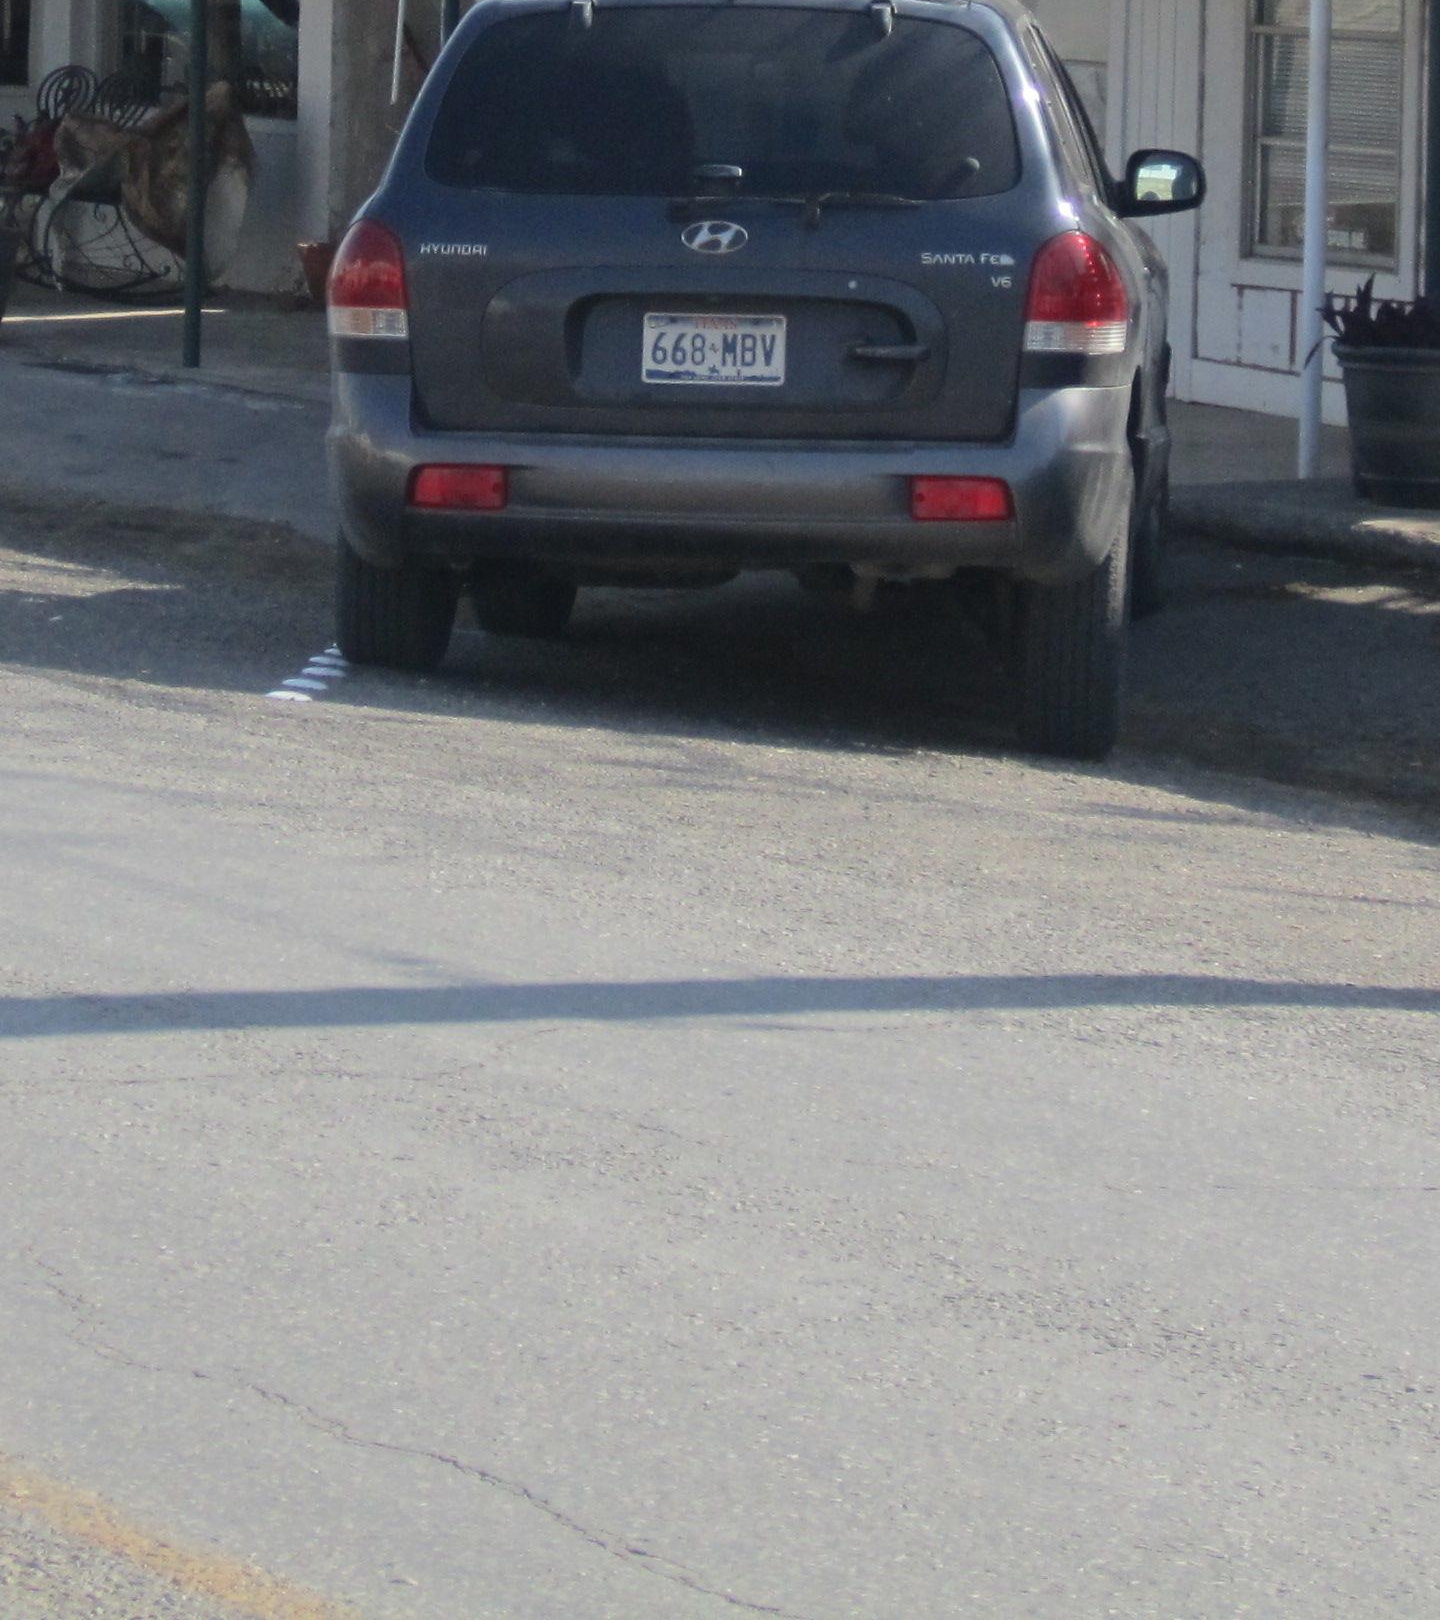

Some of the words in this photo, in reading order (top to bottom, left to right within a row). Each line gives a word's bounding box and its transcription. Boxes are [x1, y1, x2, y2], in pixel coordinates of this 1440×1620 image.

[419, 243, 488, 256] HYUNDAI
[921, 252, 975, 265] SANTA
[990, 276, 1012, 288] V6
